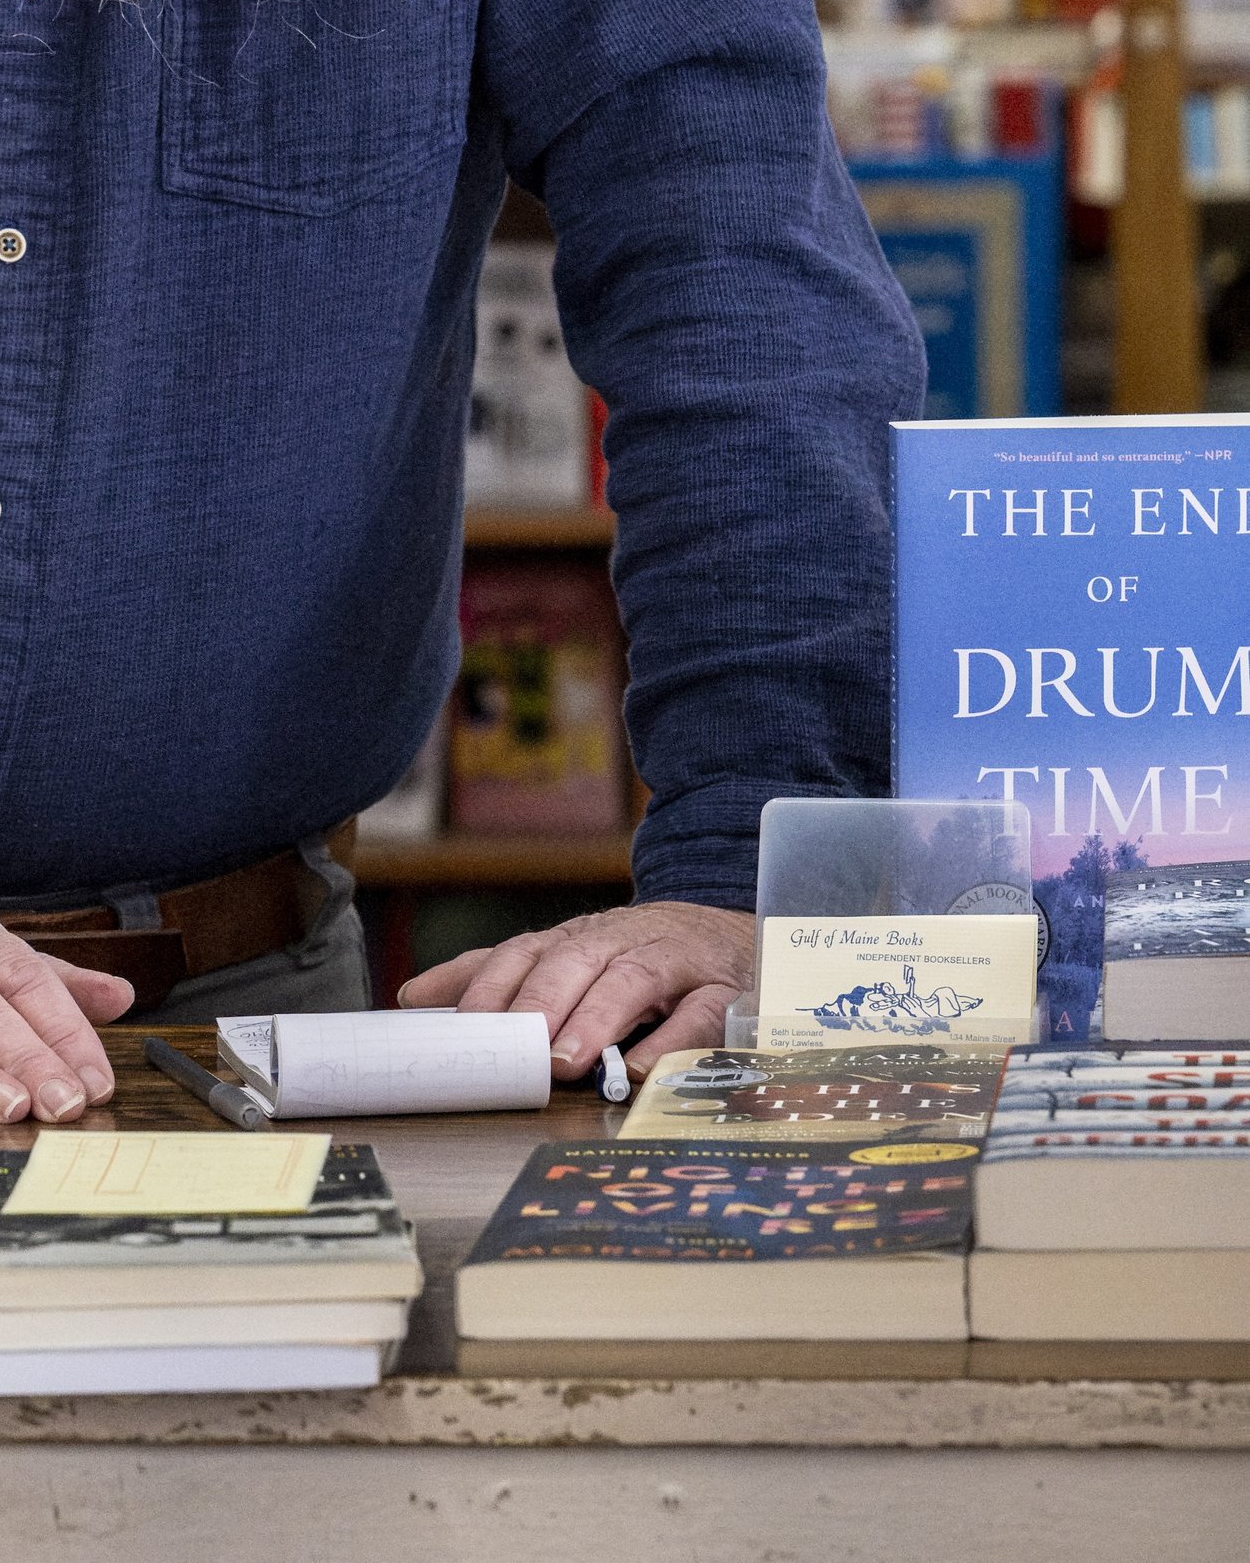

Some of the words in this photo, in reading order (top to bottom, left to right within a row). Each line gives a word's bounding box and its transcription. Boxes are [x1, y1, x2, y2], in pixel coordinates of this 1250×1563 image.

[1019, 451, 1073, 462] beautiful
[1076, 451, 1098, 462] and
[1102, 454, 1115, 462] so
[949, 488, 1096, 537] THE
[1087, 576, 1139, 603] OF
[977, 764, 1235, 837] TIME
[790, 928, 823, 949] Gulf
[823, 928, 838, 949] of
[840, 929, 879, 945] Maine
[886, 930, 924, 946] Books
[856, 953, 922, 963] INDEPENDENT
[924, 955, 991, 966] BOOKSELLERS
[771, 1028, 790, 1037] Beth
[791, 1028, 824, 1037] Leonard
[770, 1038, 789, 1048] Gary
[790, 1038, 824, 1048] Lawless
[965, 1034, 990, 1043] Maine
[992, 1034, 1016, 1043] Street
[829, 1053, 1005, 1062] HARDIN
[753, 1084, 981, 1095] THIS
[680, 1100, 956, 1110] OTHE
[713, 1112, 988, 1123] EDEN
[565, 1149, 677, 1157] NATIONAL
[687, 1150, 810, 1158] BESTSELLER
[545, 1164, 871, 1181] NIGHT
[600, 1182, 738, 1198] OF
[784, 1176, 967, 1198] THE
[519, 1199, 879, 1218] LIVING
